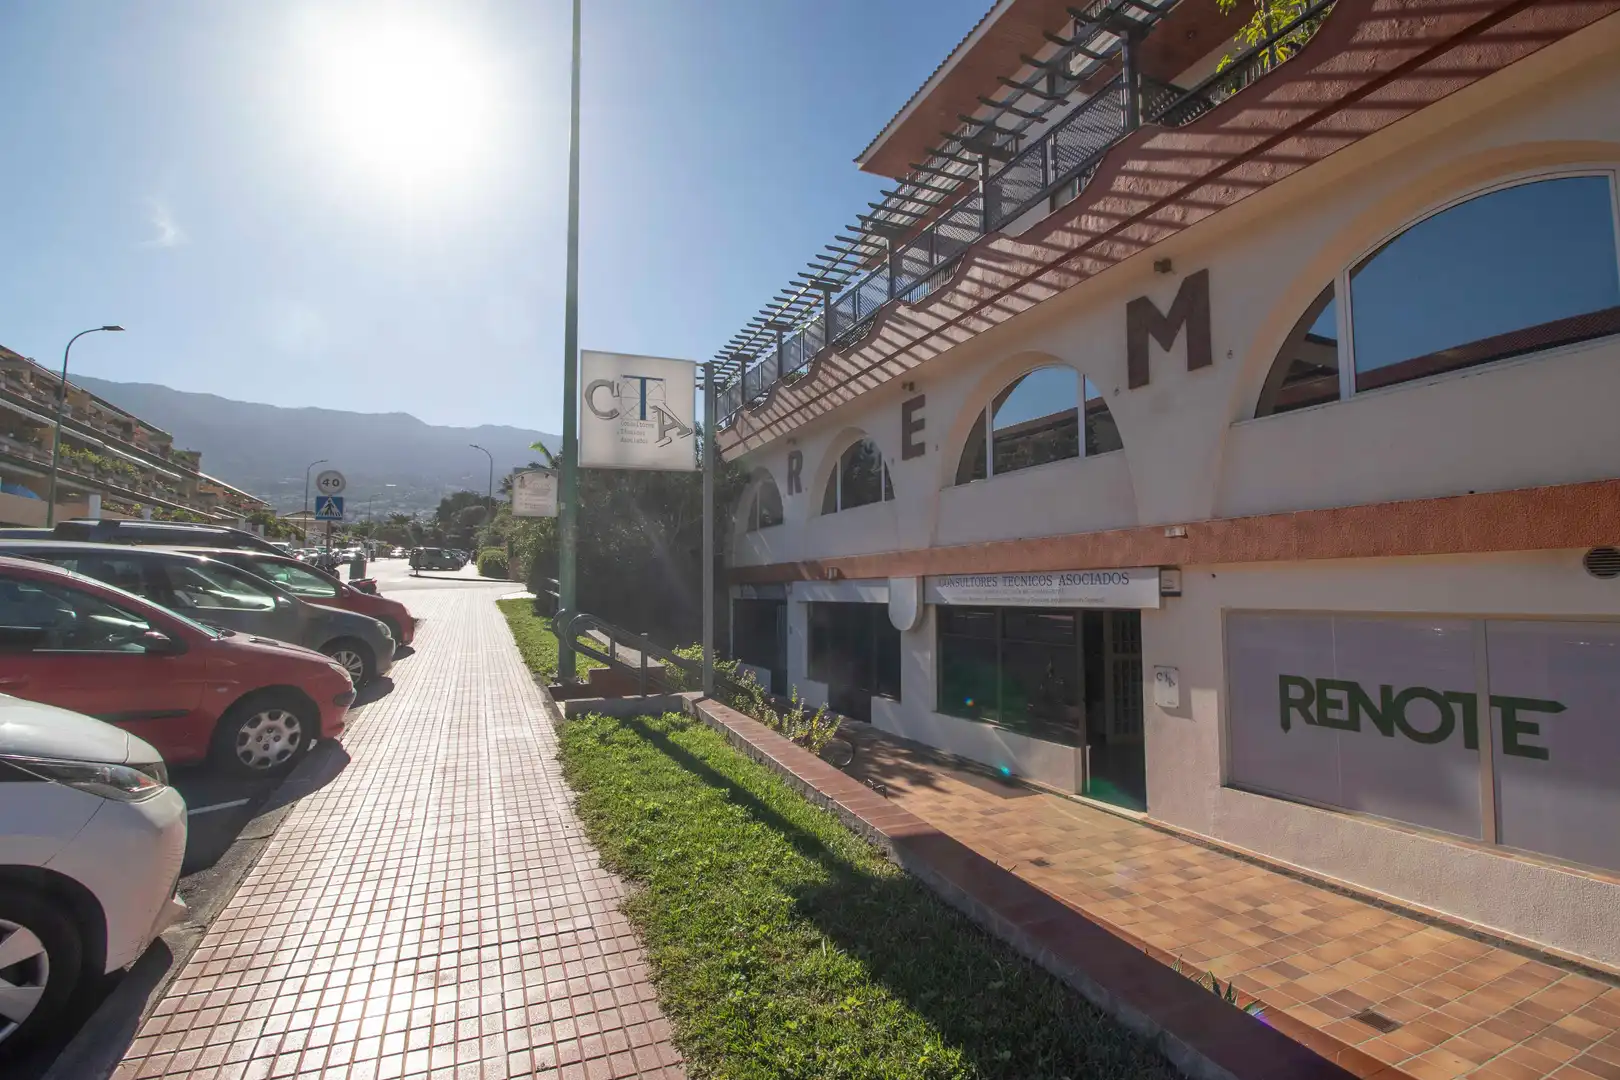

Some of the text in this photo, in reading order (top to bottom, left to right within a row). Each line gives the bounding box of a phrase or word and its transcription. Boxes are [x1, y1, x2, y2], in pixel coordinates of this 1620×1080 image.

[787, 268, 1212, 495] R E M
[322, 478, 340, 487] 40
[1058, 572, 1129, 586] ASOCIADOS
[1278, 674, 1568, 761] RENOTE
